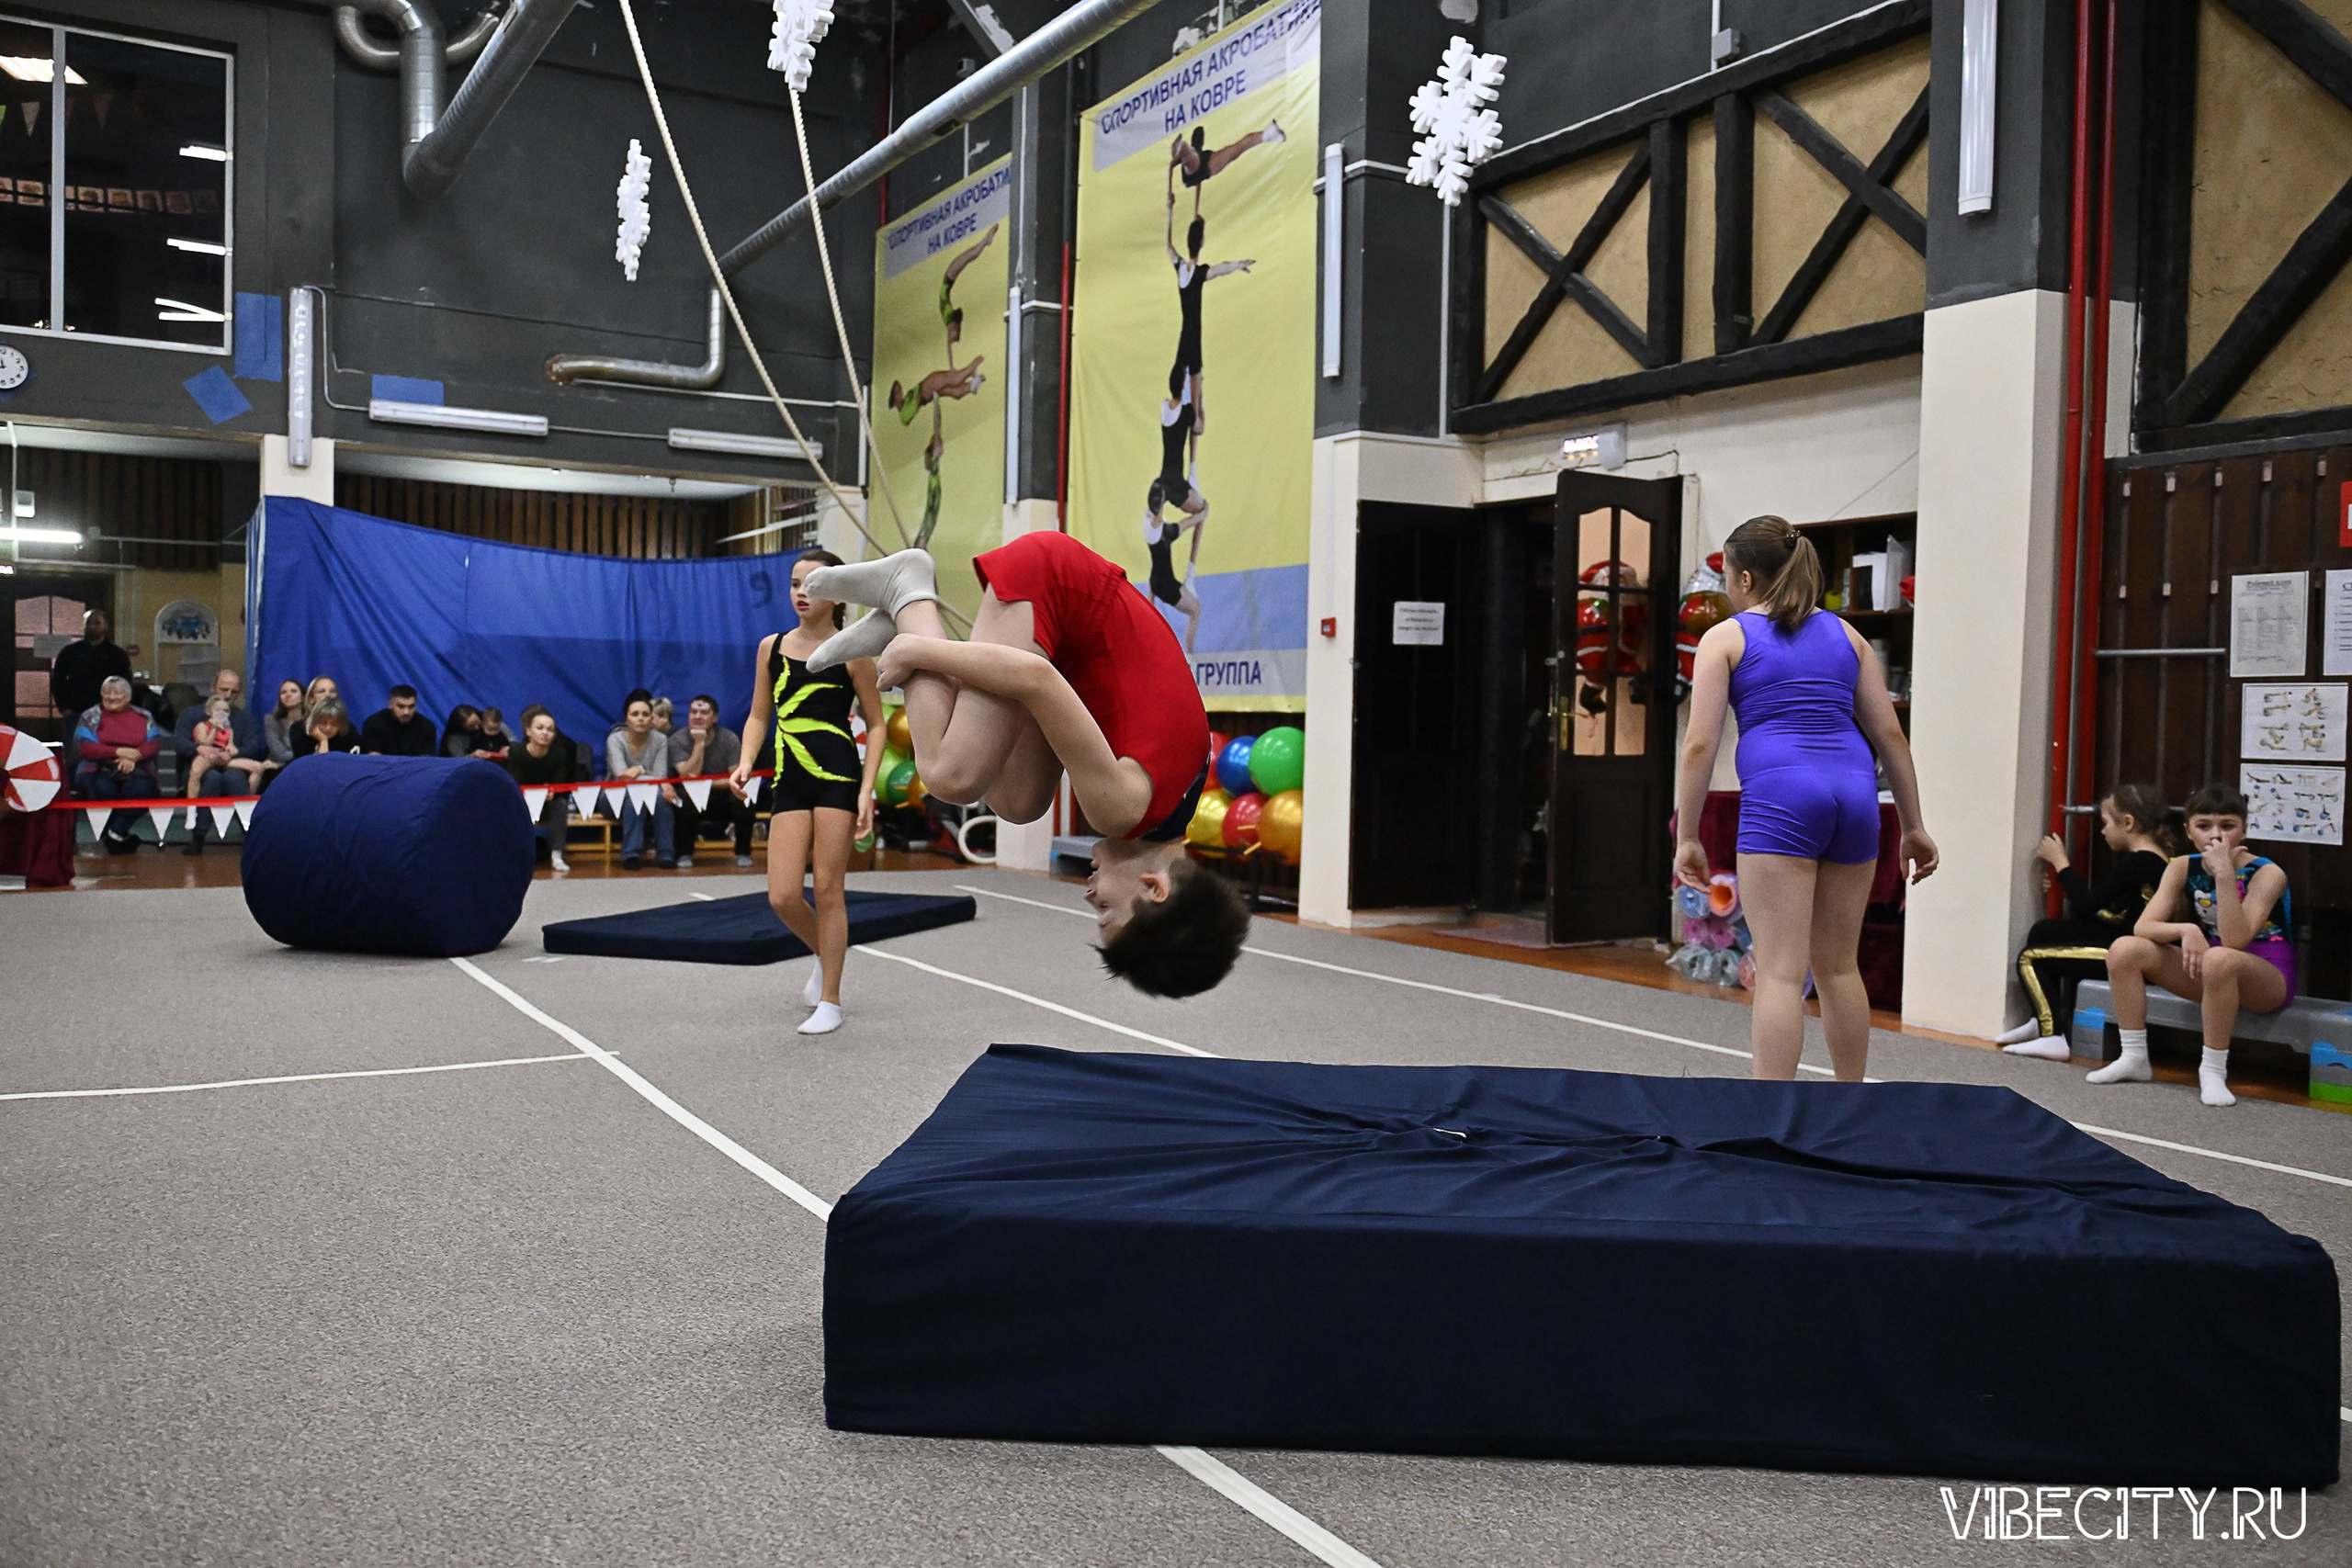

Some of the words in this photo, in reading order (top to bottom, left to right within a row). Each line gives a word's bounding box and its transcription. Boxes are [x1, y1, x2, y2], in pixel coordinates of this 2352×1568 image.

[1102, 60, 1203, 135] СПОРТИВНАЯ
[1165, 109, 1186, 133] НА
[1191, 70, 1247, 120] КОВРЕ
[887, 199, 952, 250] СПОРТИВНАЯ
[927, 234, 942, 254] НА
[943, 212, 978, 247] КОВРЕ
[1196, 660, 1262, 686] ГРУППА
